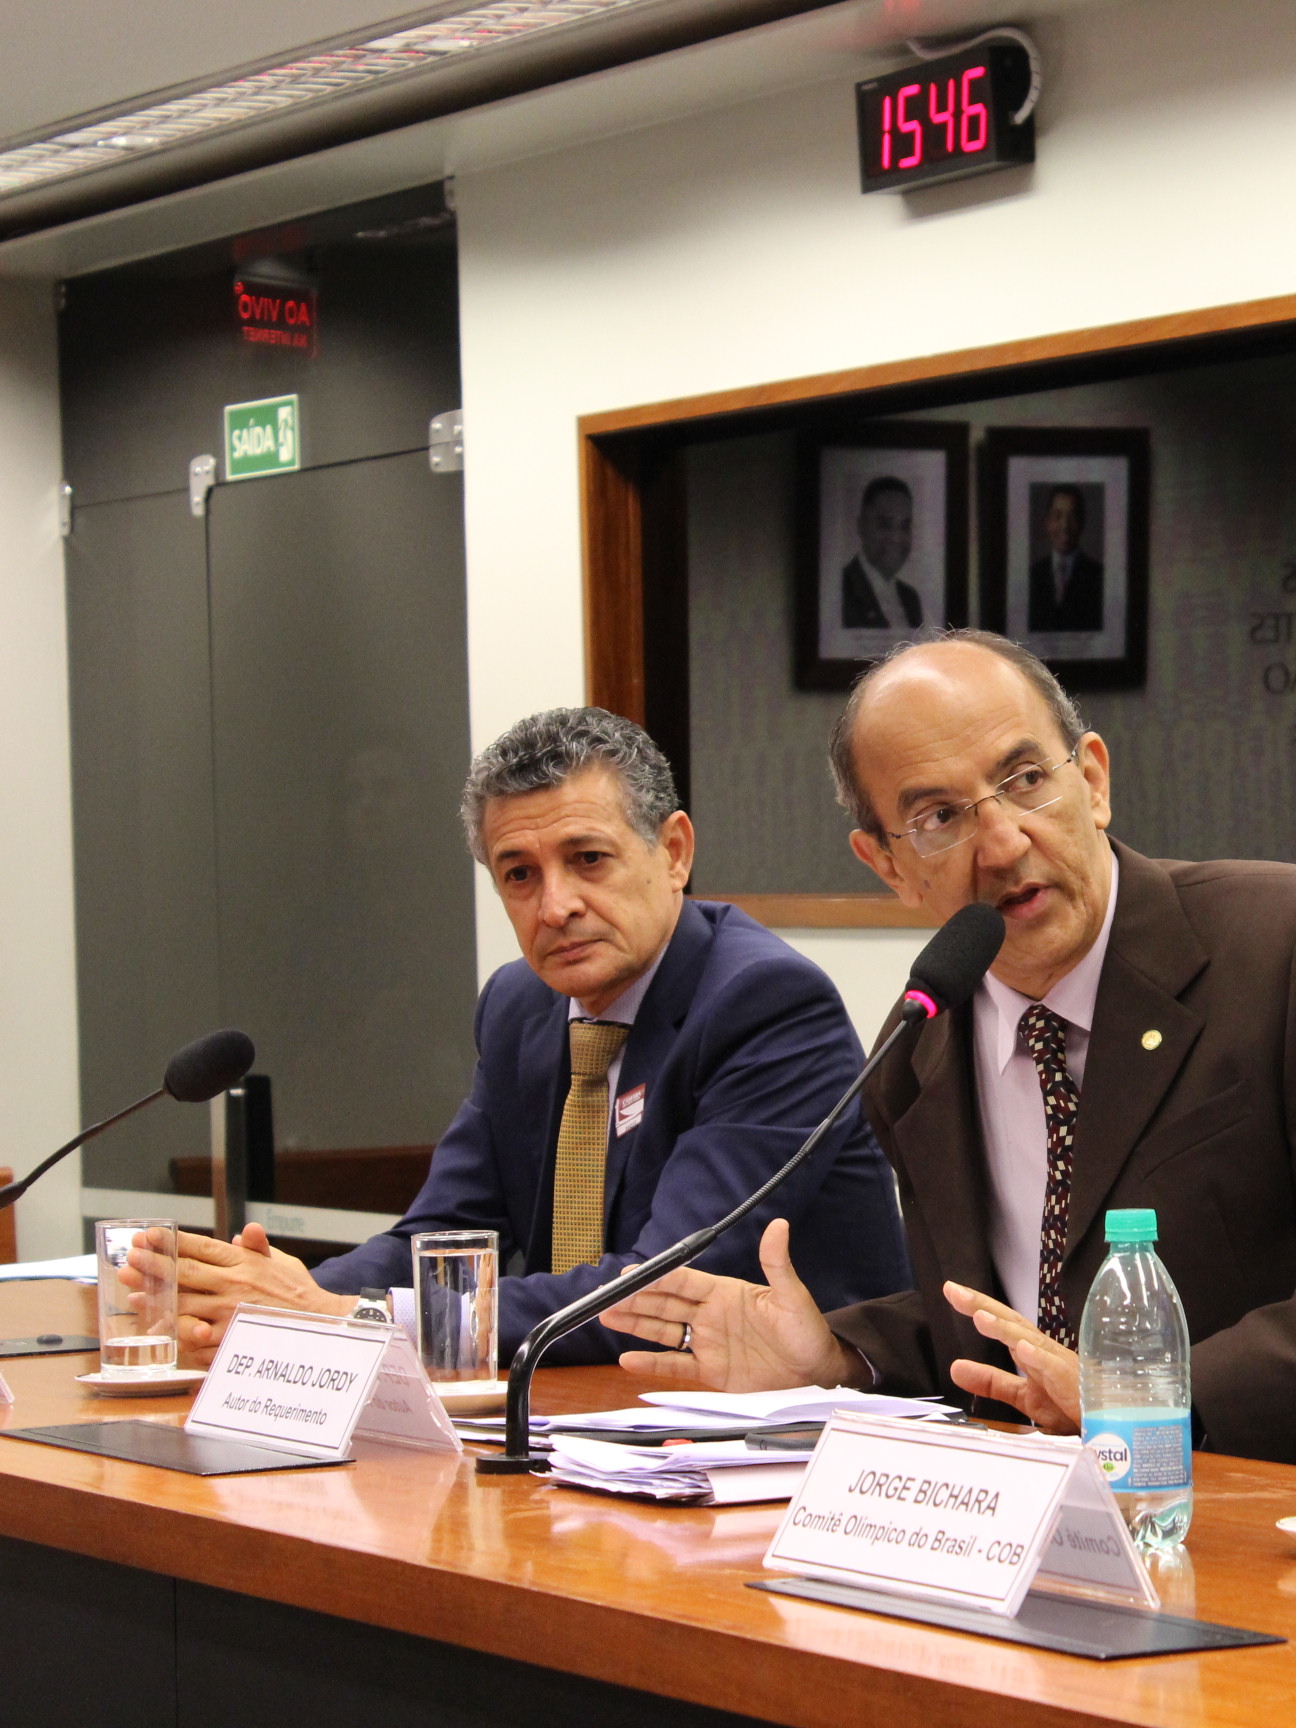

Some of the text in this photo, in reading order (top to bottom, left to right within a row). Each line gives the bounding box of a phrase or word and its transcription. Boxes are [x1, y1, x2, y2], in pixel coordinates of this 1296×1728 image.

[882, 66, 987, 169] 1546
[232, 417, 276, 459] SAÍDA
[226, 1354, 359, 1392] DEP. ARNALDO JORDY
[222, 1392, 327, 1425] Autor do Requerimento
[848, 1469, 1000, 1517] JORGE BICHARA
[792, 1506, 843, 1533] Comitê
[844, 1514, 906, 1545] Olímpico
[908, 1526, 928, 1549] do
[930, 1530, 977, 1557] Brasil
[986, 1540, 1025, 1566] COB
